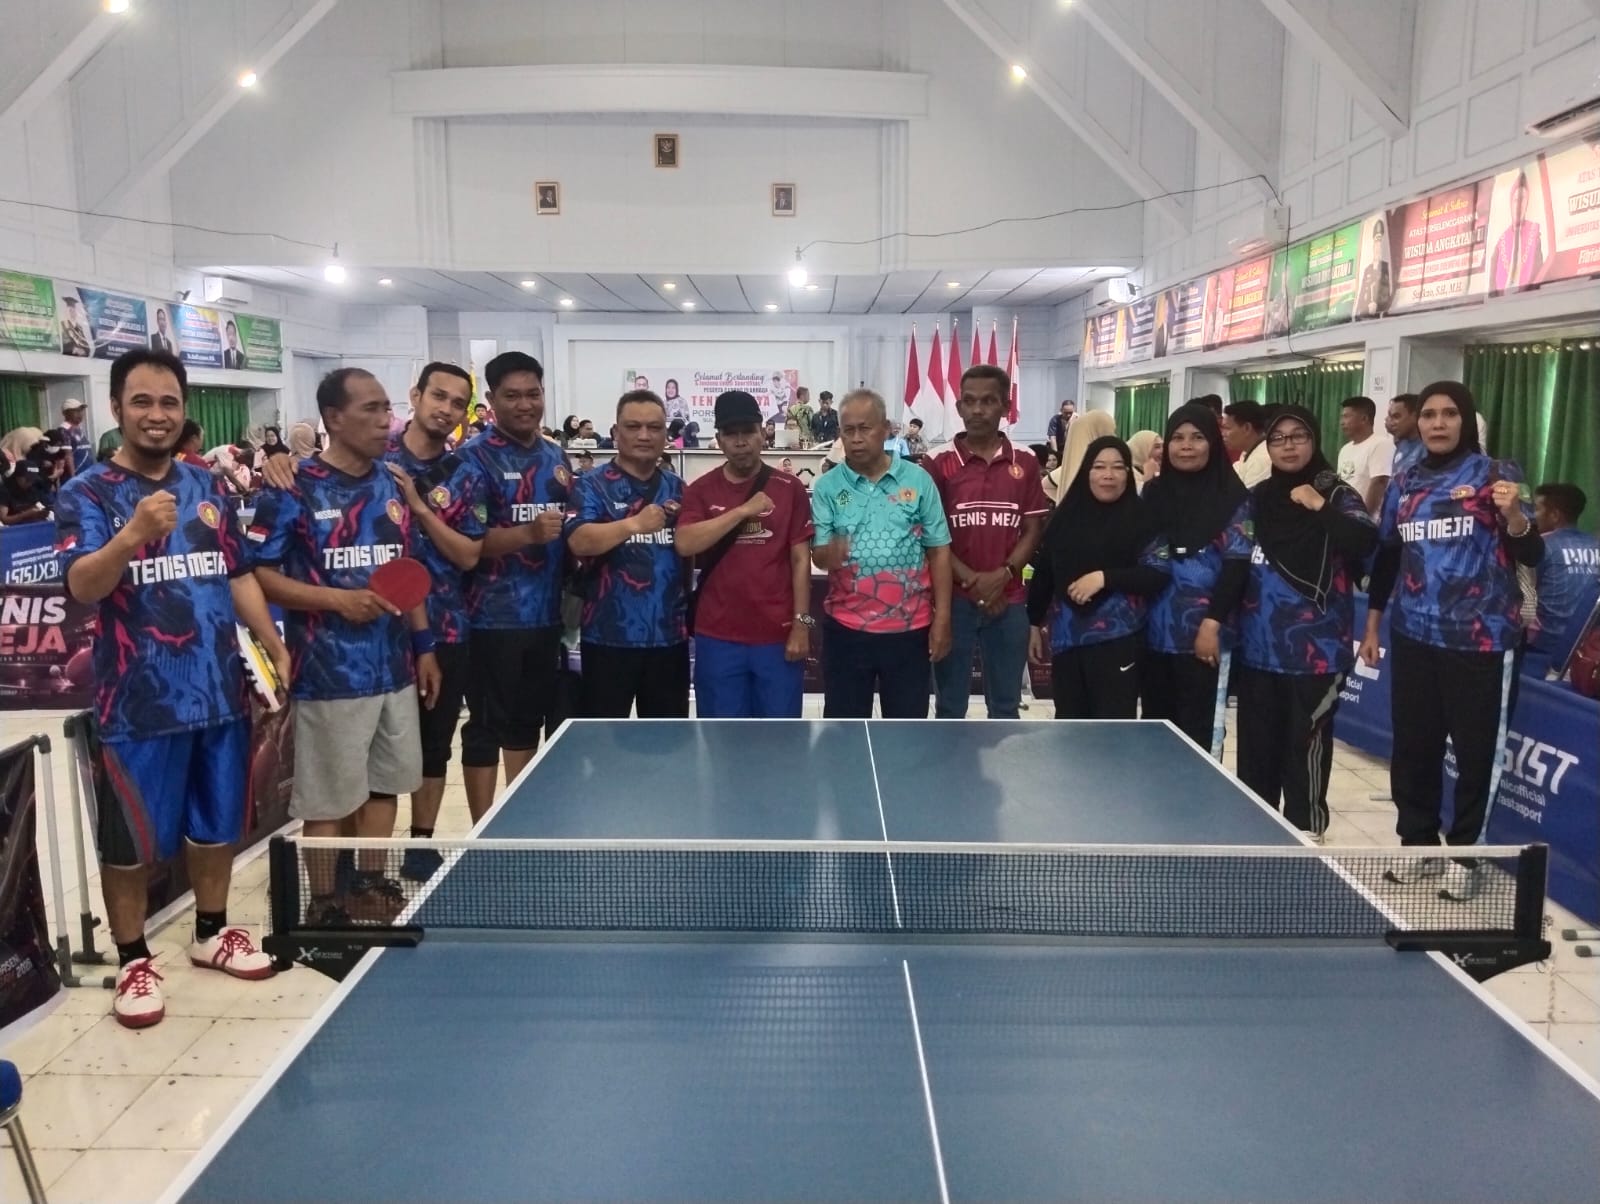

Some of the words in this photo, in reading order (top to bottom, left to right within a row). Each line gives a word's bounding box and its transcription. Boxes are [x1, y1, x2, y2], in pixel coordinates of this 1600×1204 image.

[1568, 192, 1600, 211] WISU
[691, 396, 713, 407] TEN
[692, 409, 716, 417] PORS
[950, 511, 987, 528] TENIS
[1397, 521, 1425, 543] NIS
[1428, 515, 1474, 540] MEJA
[128, 554, 188, 586] TENIS
[322, 545, 371, 570] TENIS
[0, 596, 66, 625] NIS
[0, 624, 67, 655] EJA
[1499, 730, 1580, 795] SIST
[1500, 778, 1546, 807] nicofficial
